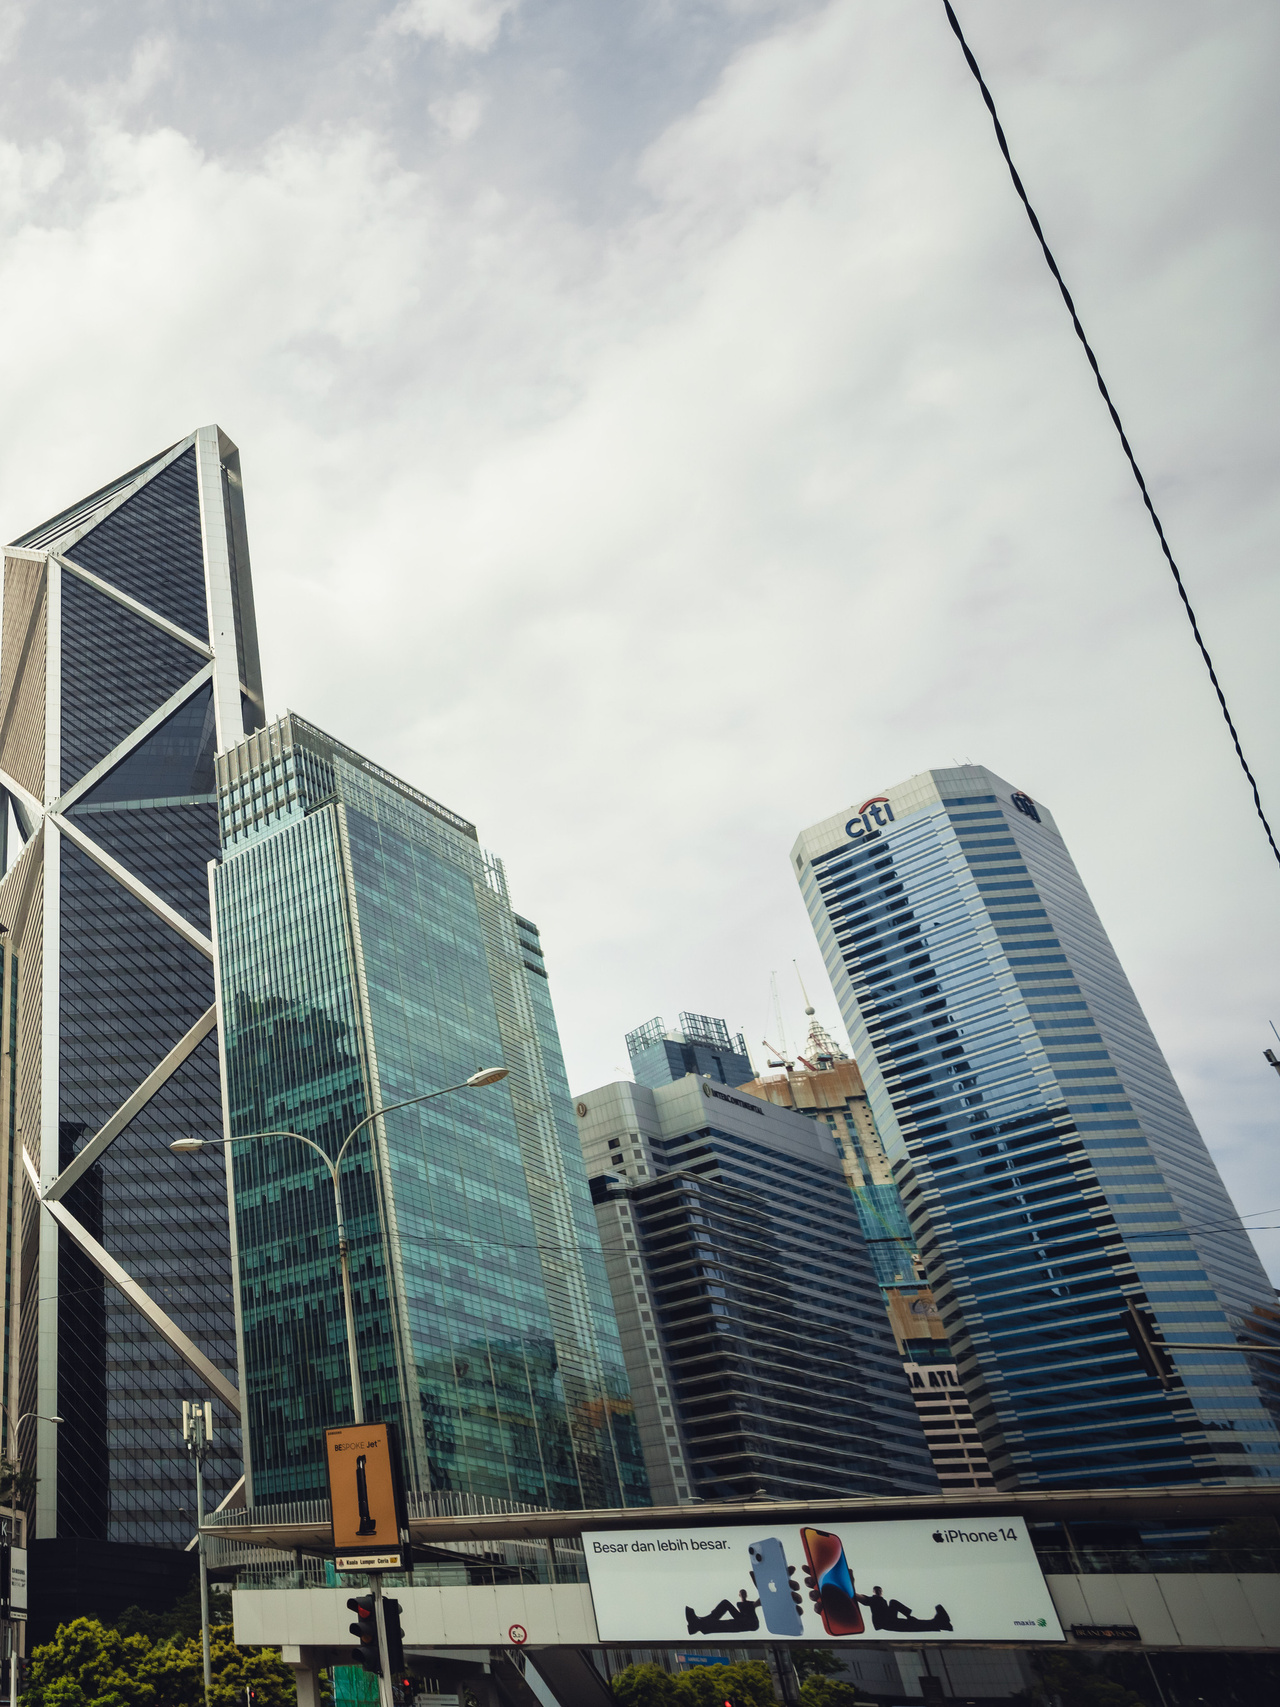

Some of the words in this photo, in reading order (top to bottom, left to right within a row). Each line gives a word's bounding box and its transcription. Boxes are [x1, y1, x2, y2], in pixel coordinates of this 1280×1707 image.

[845, 797, 895, 838] citi
[334, 1442, 365, 1451] BESPOKE
[943, 1529, 998, 1543] iPhone
[998, 1528, 1018, 1541] 14
[593, 1541, 629, 1553] Besar
[631, 1540, 656, 1552] dan
[656, 1539, 689, 1551] lebih
[690, 1538, 731, 1550] besar.
